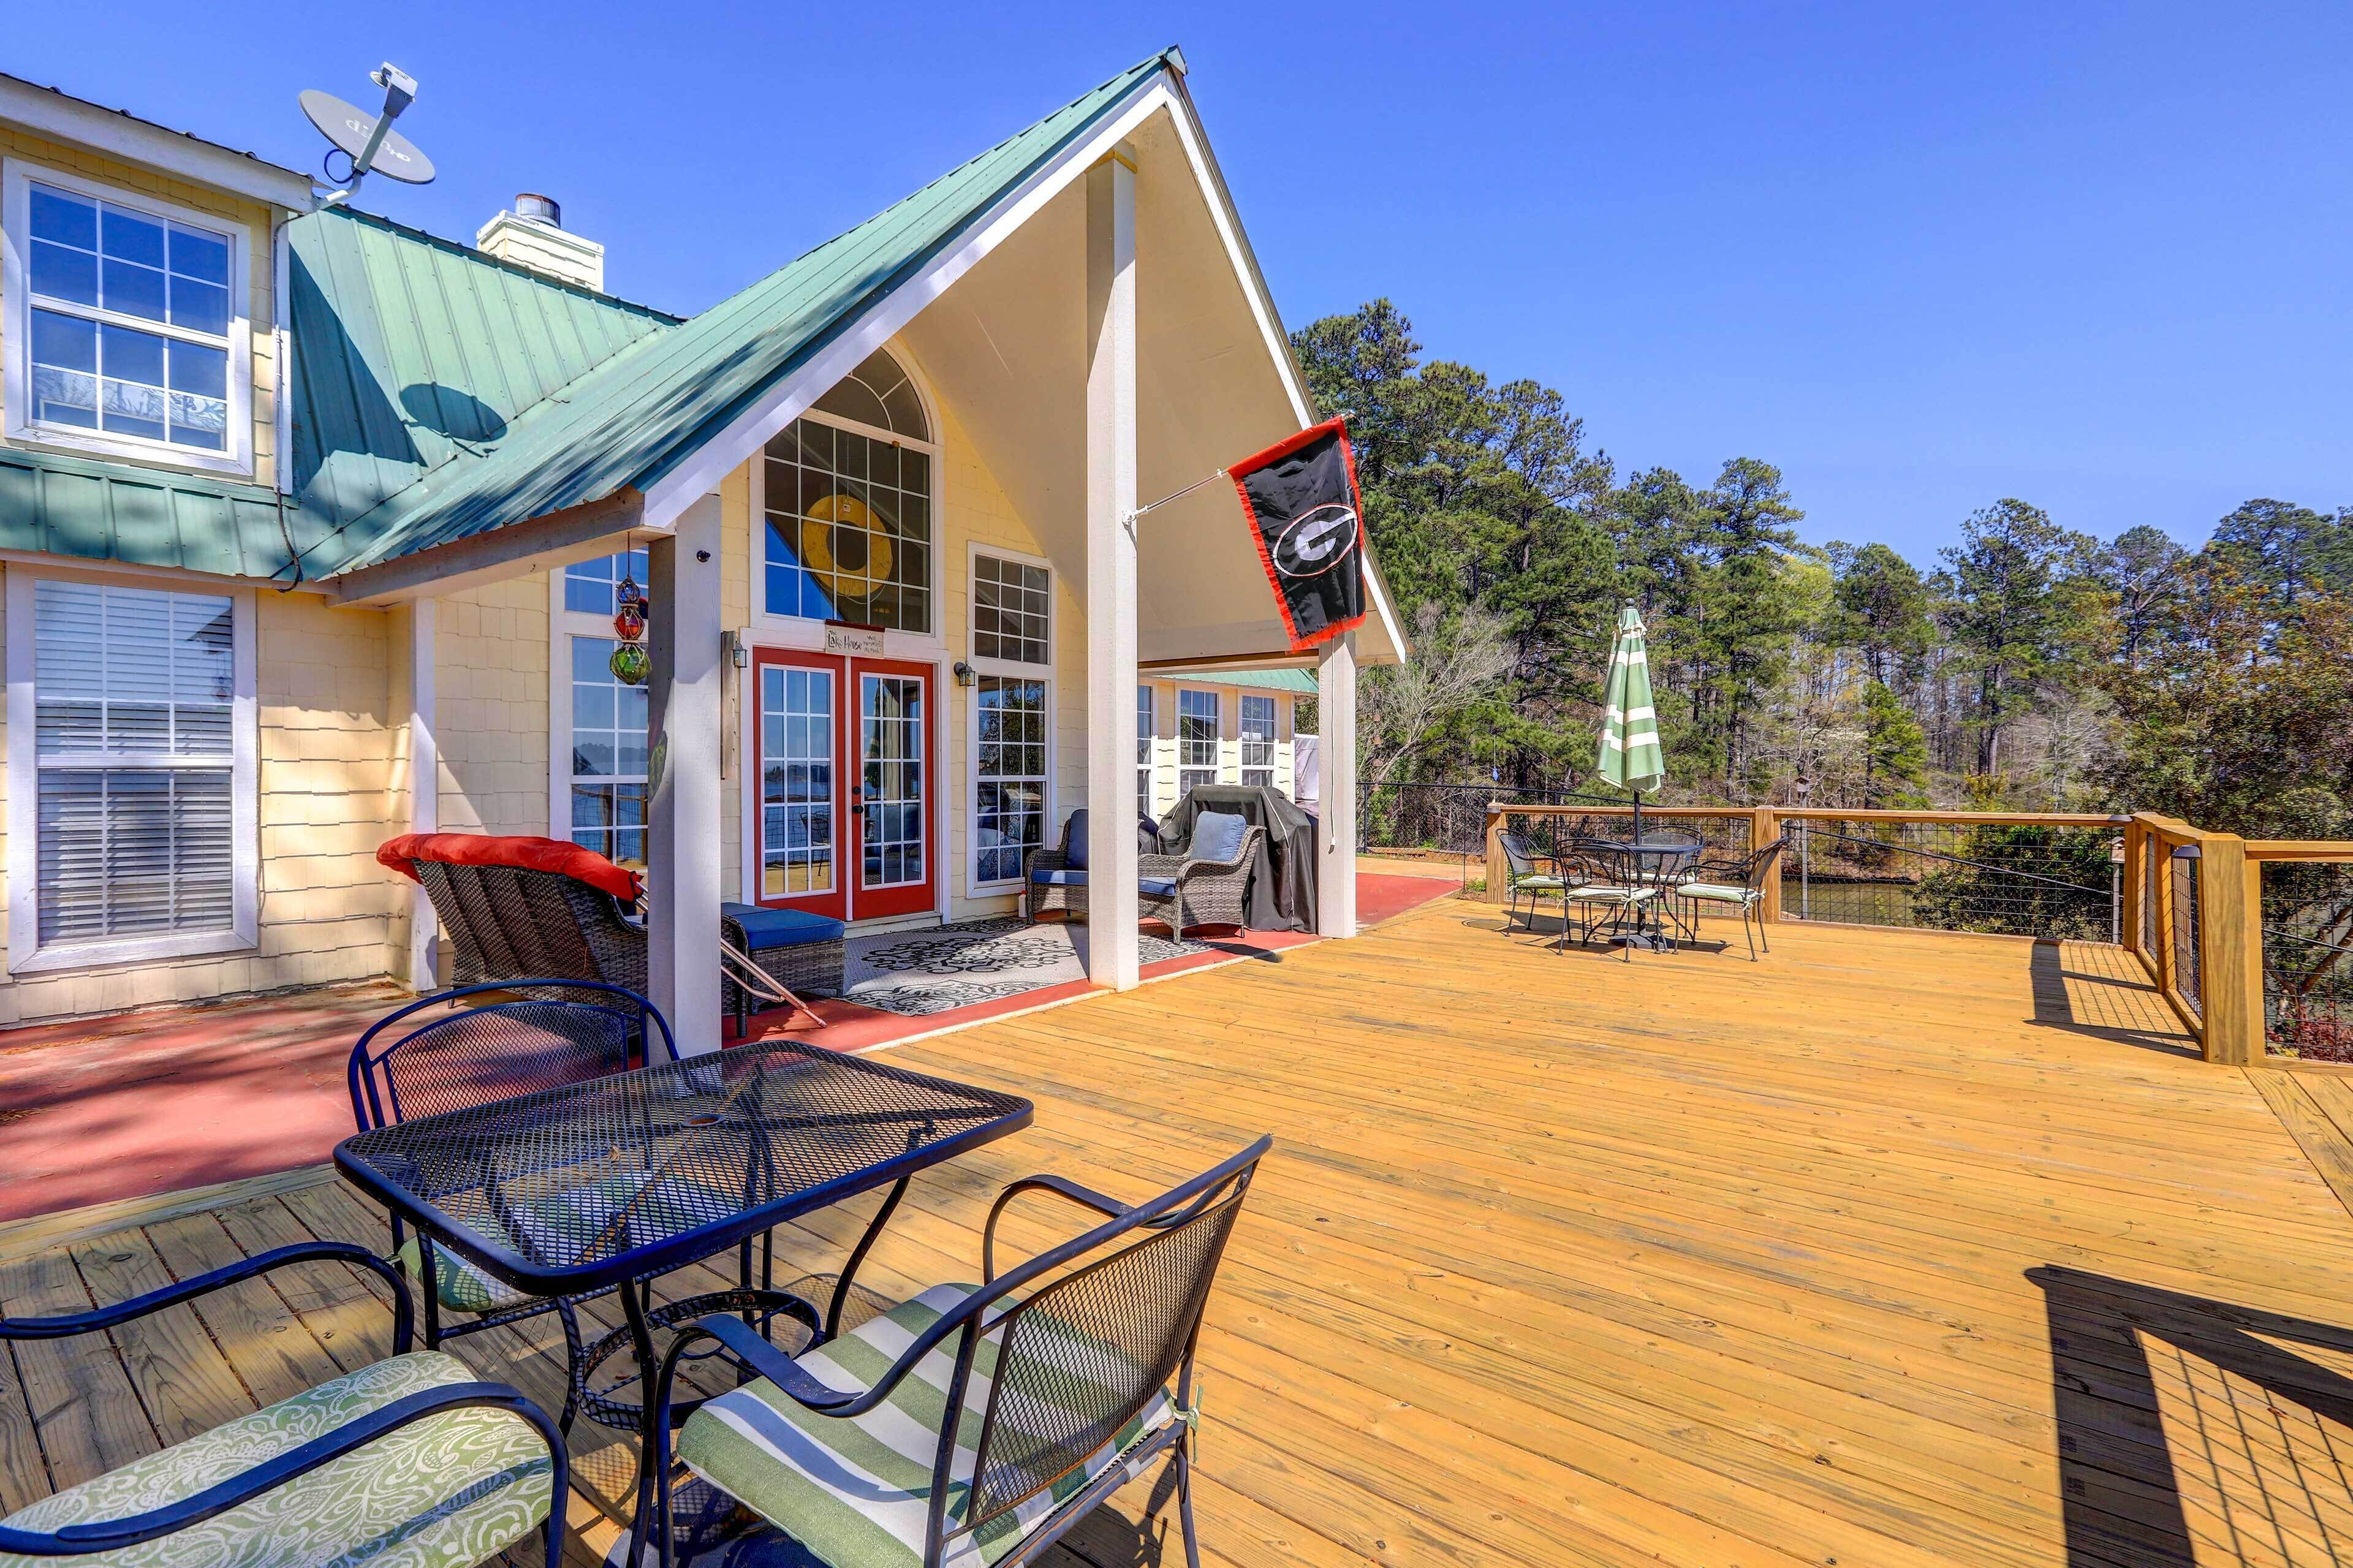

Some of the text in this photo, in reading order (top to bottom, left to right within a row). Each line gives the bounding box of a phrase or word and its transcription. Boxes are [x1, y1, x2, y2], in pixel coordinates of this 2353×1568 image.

[1294, 512, 1355, 561] G
[828, 632, 862, 650] Lake House
